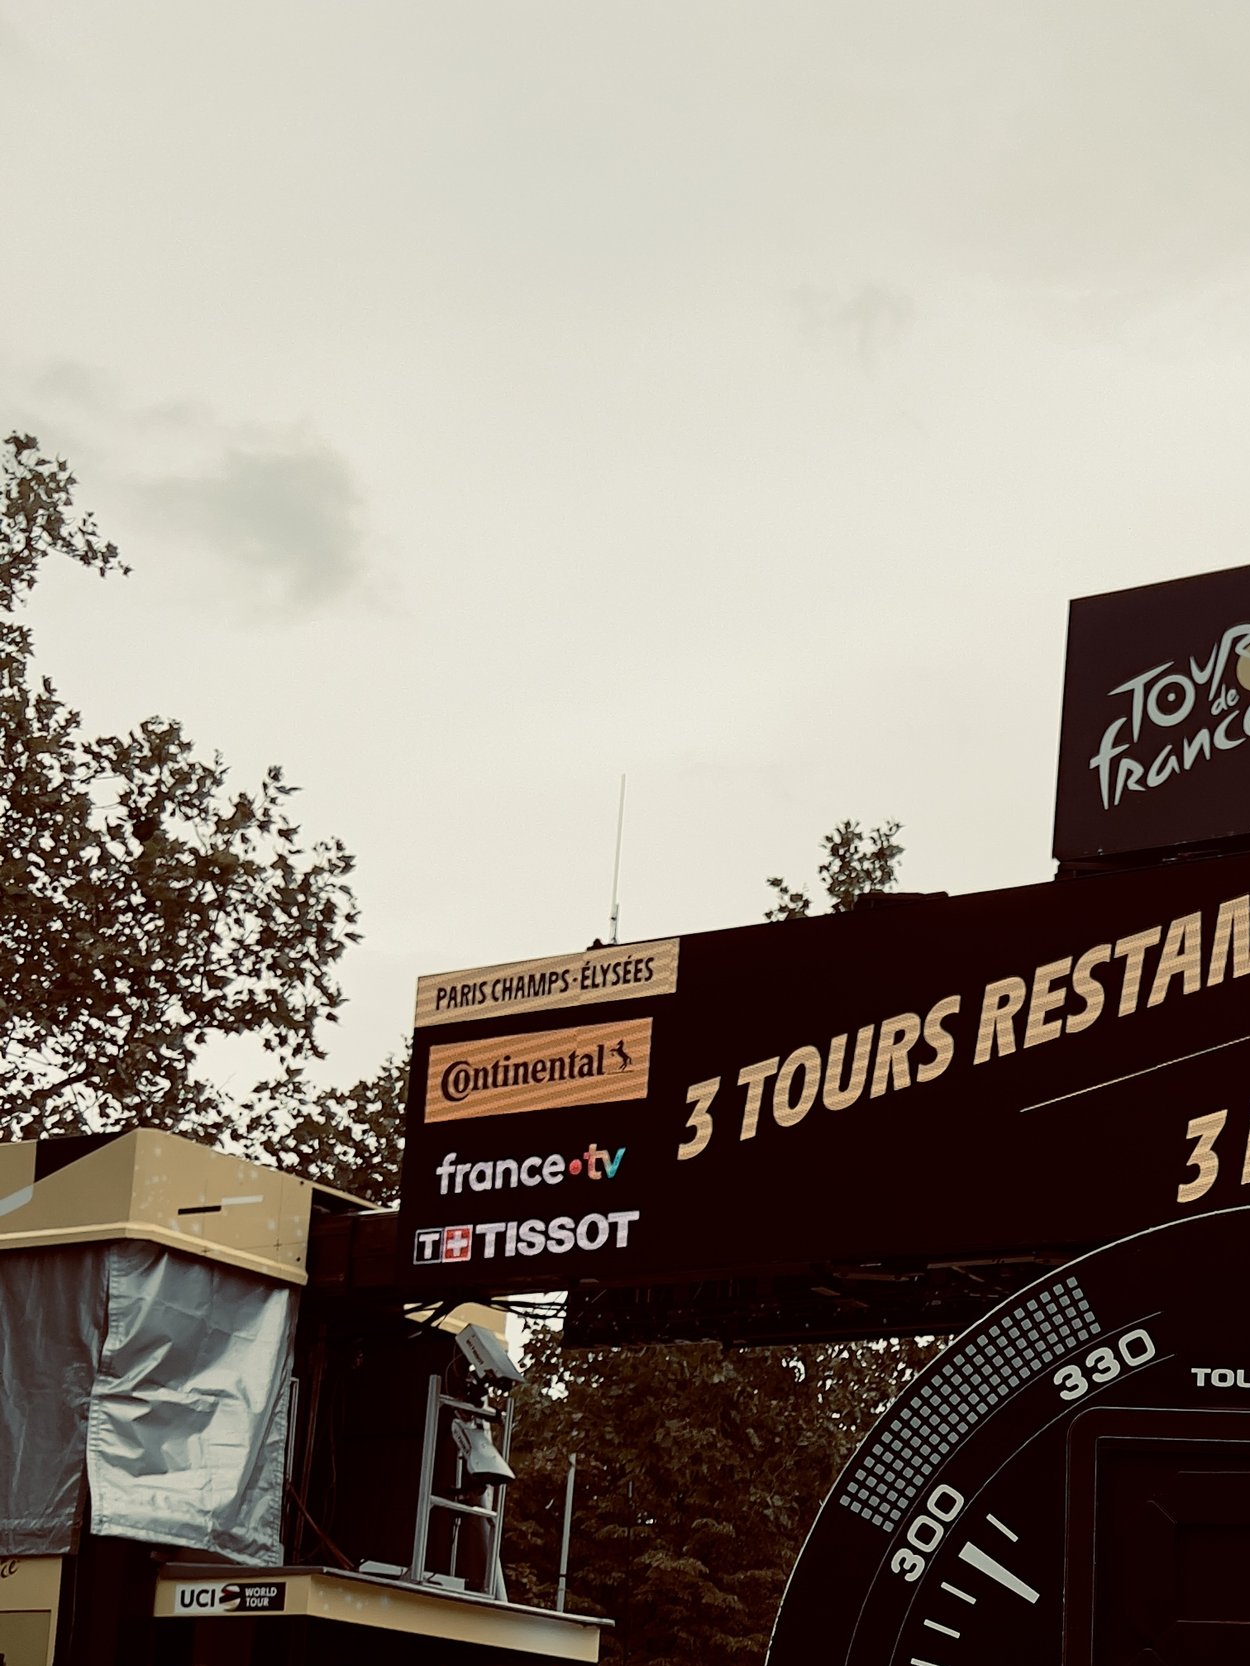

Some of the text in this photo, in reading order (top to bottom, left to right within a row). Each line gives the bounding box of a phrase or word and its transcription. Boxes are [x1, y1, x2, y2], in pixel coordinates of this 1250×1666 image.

[1211, 687, 1239, 715] de
[436, 981, 488, 1010] PARIS
[441, 1044, 606, 1101] Continental
[677, 1076, 722, 1160] 3
[737, 995, 961, 1142] TOURS
[1177, 1109, 1227, 1202] 3
[476, 1211, 640, 1257] TISSOT
[1053, 1328, 1155, 1400] 330
[891, 1484, 965, 1582] 300
[180, 1588, 216, 1608] UCI
[245, 1587, 278, 1597] WORLD
[245, 1597, 270, 1607] TOUR
